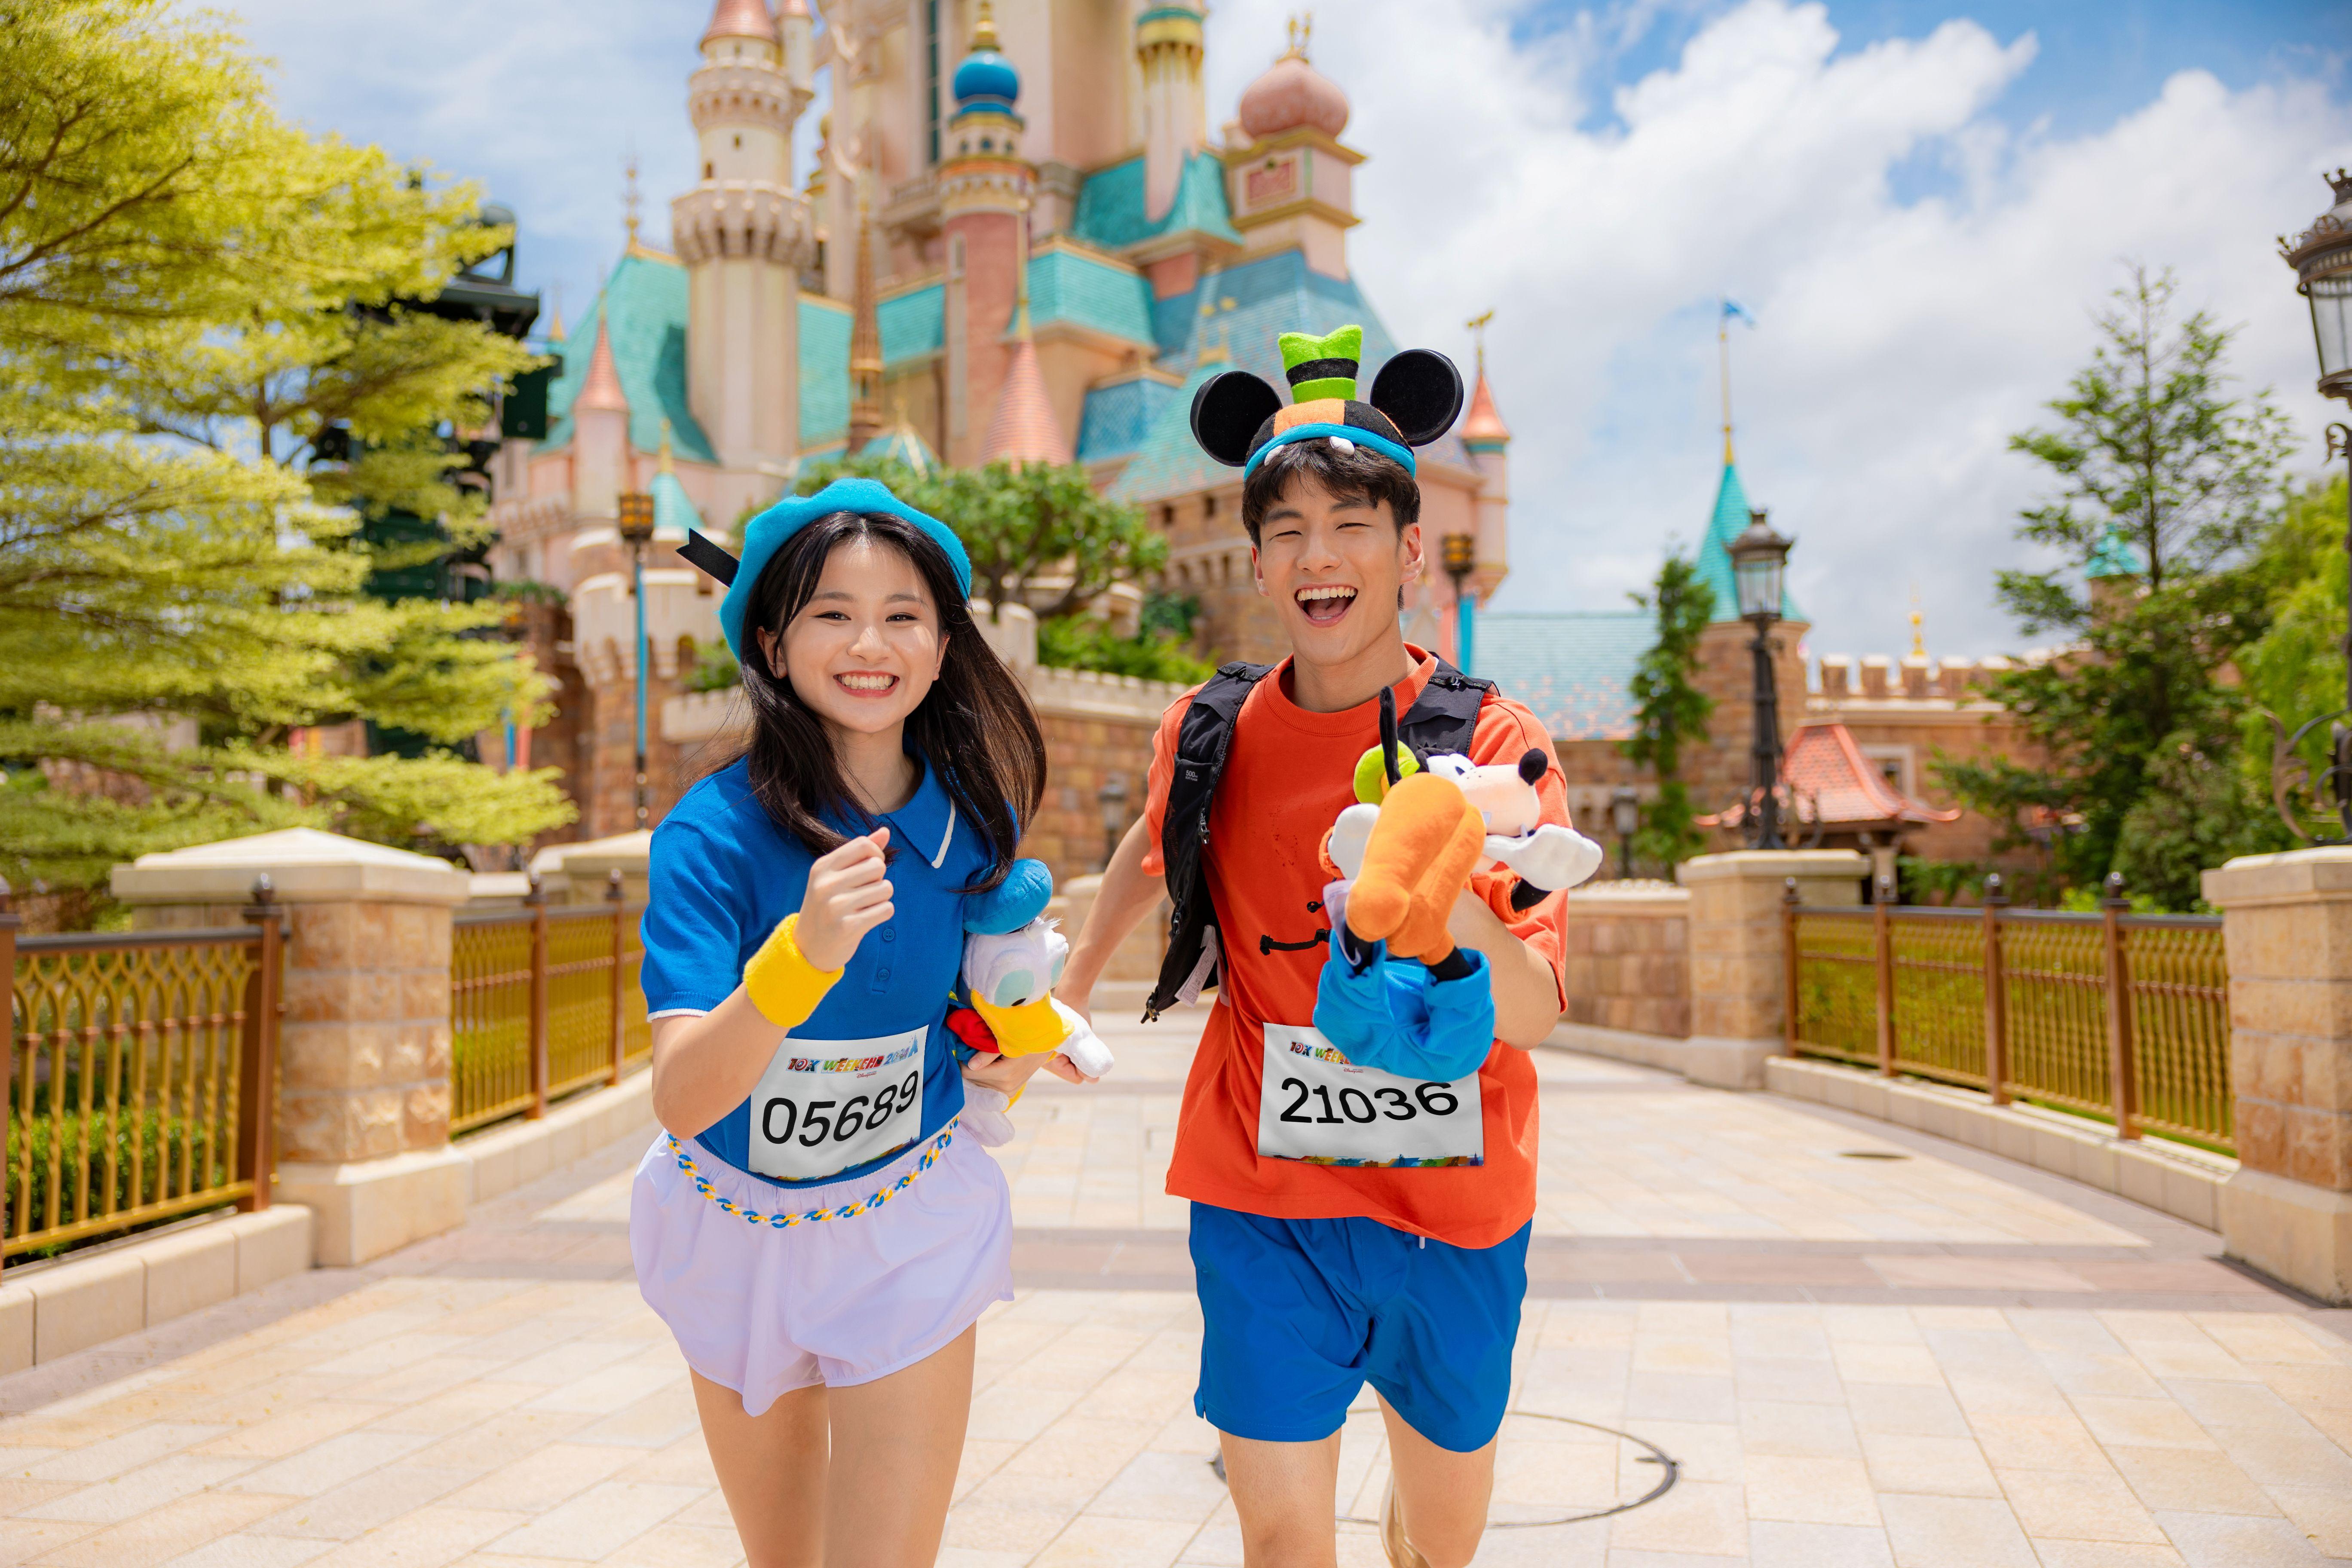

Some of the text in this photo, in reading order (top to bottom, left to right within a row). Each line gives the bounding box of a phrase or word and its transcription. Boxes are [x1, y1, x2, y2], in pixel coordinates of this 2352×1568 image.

[787, 1057, 821, 1073] 10K
[822, 1054, 885, 1073] WEEKEND
[1289, 1041, 1352, 1066] 10K WEEK
[762, 1070, 919, 1147] 05689
[1280, 1077, 1458, 1124] 21036
